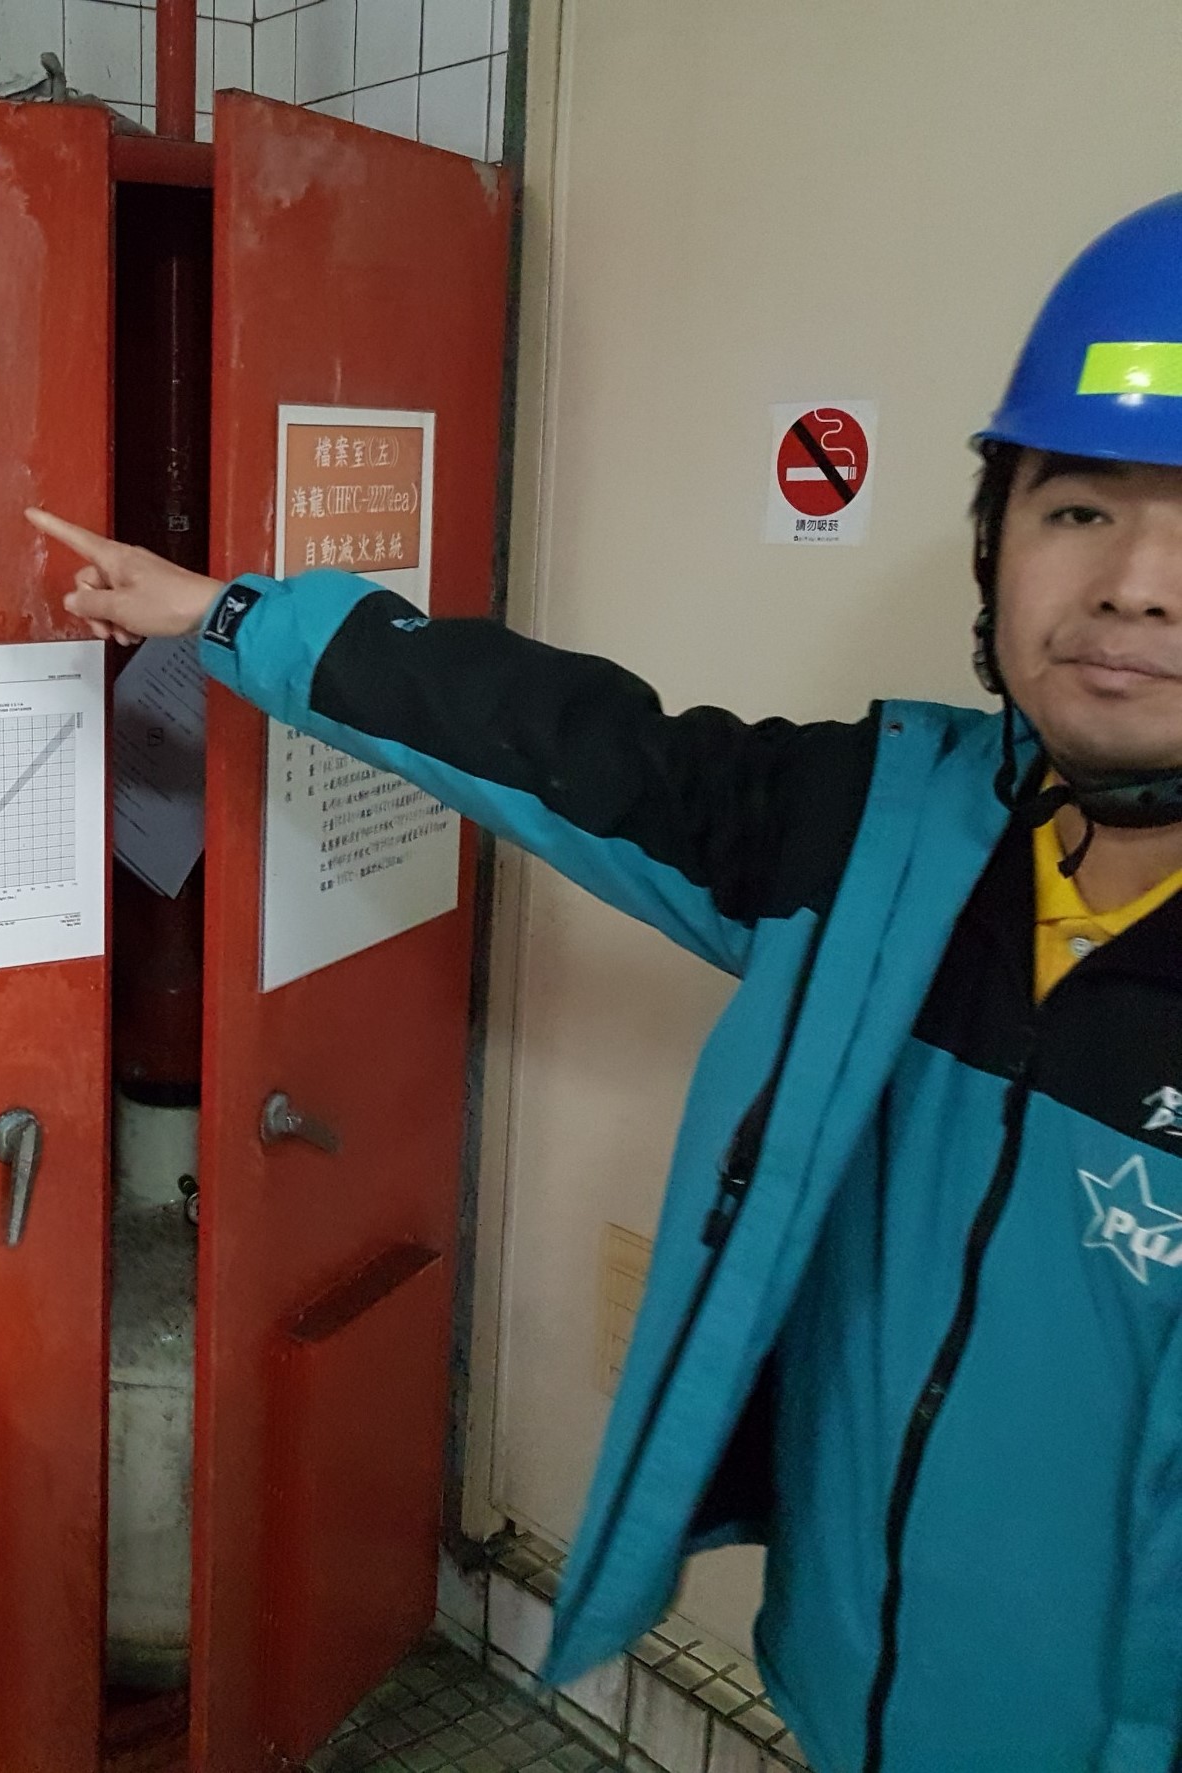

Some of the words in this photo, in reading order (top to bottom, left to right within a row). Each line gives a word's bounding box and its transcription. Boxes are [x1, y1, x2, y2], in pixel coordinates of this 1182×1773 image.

[314, 434, 400, 469] 檔案室(左)
[290, 482, 419, 519] 海龍(HFC-227ea)
[795, 519, 839, 532] 請勿吸菸
[304, 531, 404, 567] 自動滅火系統
[1102, 1206, 1182, 1268] PU
